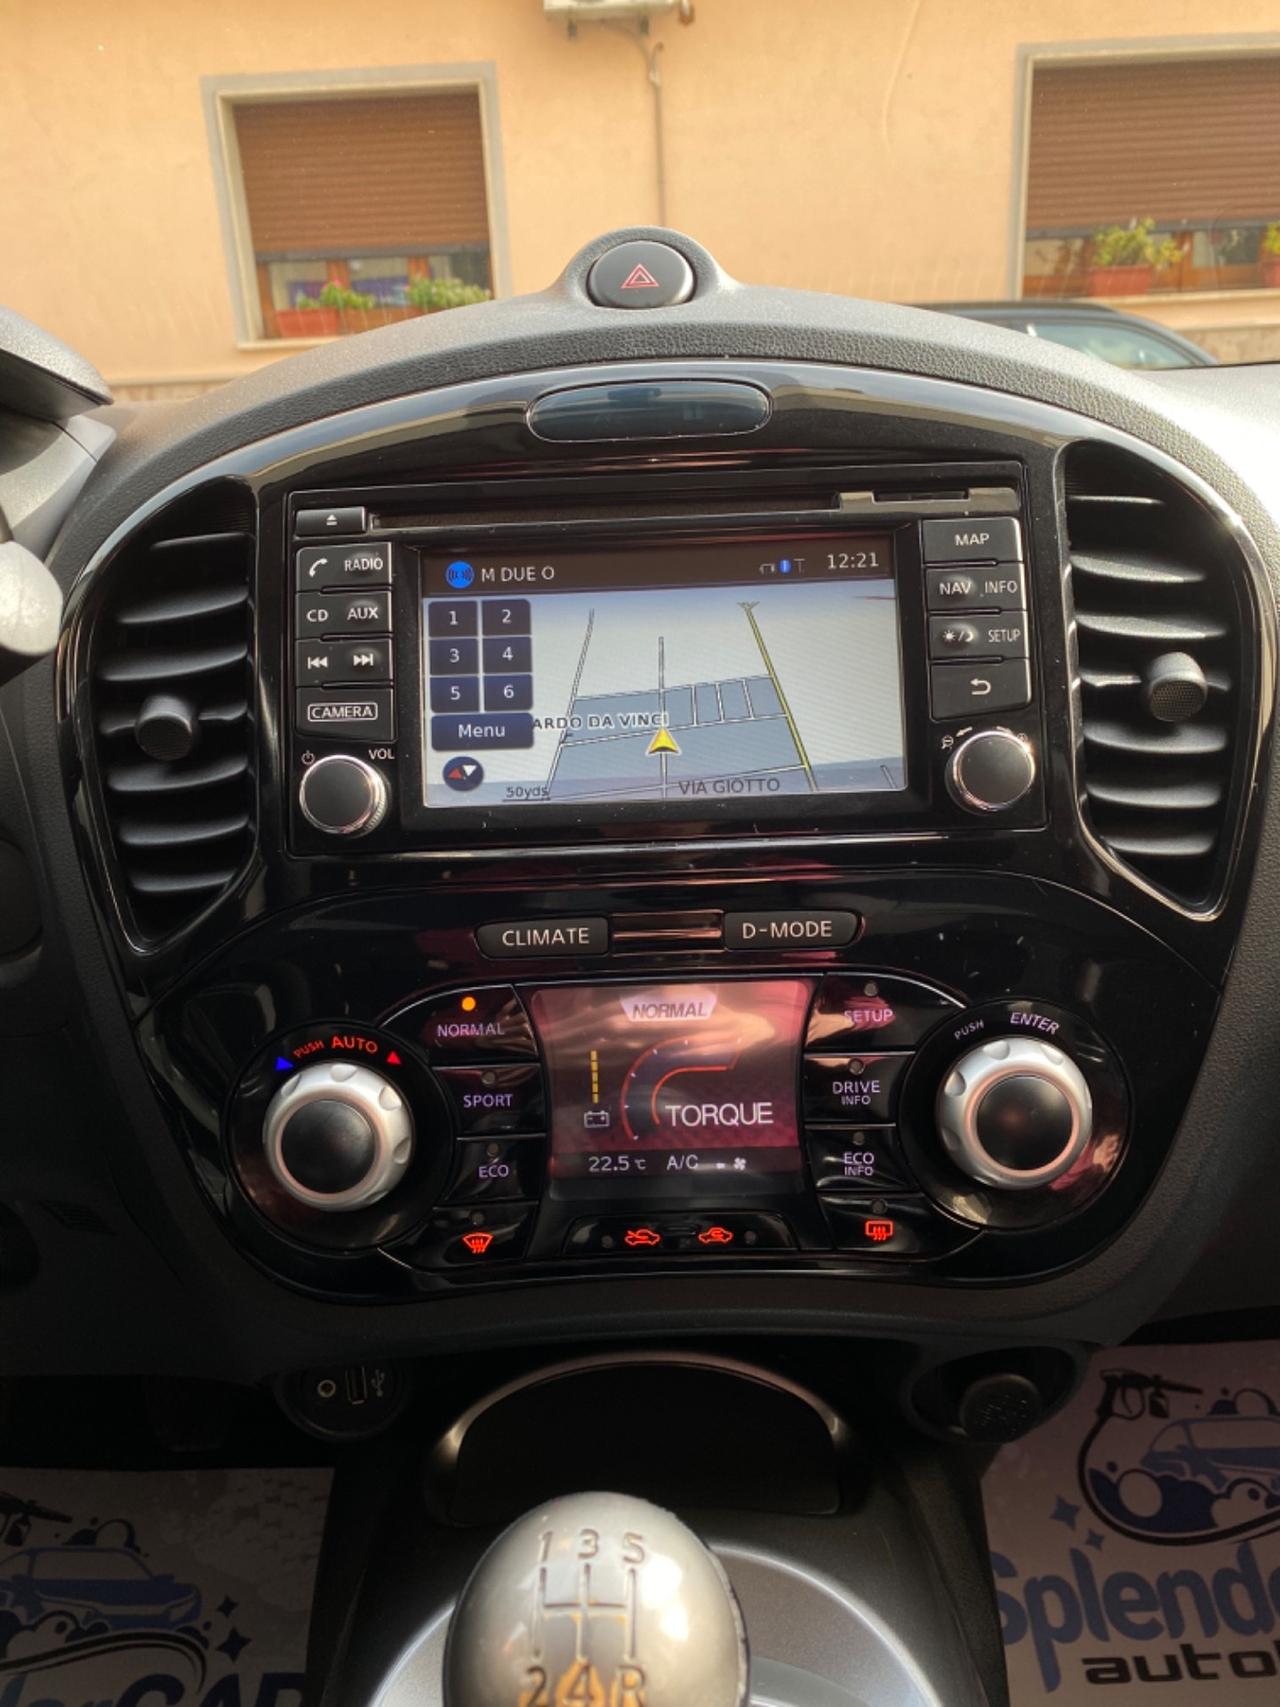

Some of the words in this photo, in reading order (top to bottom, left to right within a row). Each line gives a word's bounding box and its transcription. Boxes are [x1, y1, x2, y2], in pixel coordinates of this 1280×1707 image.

[954, 532, 991, 547] MAP
[343, 557, 384, 572] RADIO
[826, 552, 879, 570] 12:21
[481, 567, 496, 582] M
[500, 566, 536, 582] DUE
[541, 566, 556, 580] O
[939, 581, 972, 595] NAV
[984, 580, 1018, 594] INFO
[306, 609, 329, 623] CD
[347, 606, 380, 620] AUX
[448, 611, 459, 625] 1
[501, 609, 513, 624] 2
[987, 629, 1021, 643] SETUP
[449, 648, 460, 663] 3
[502, 647, 514, 661] 4
[450, 686, 461, 701] 5
[503, 684, 515, 699] 6
[311, 704, 375, 719] CAMERA
[532, 716, 583, 731] ARDO
[588, 714, 614, 728] DA
[619, 712, 669, 727] VINCI
[457, 723, 506, 739] Menu
[368, 748, 395, 761] VOL
[505, 785, 549, 801] 50yds
[679, 780, 710, 795] VIA
[712, 778, 781, 794] GIOTTO
[501, 927, 591, 947] CLIMATE
[742, 920, 833, 940] D-MODE
[632, 1002, 707, 1020] NORMAL
[843, 1008, 894, 1024] SETUP
[436, 1022, 505, 1038] NORMAL
[953, 1018, 985, 1041] PUSH
[1009, 1011, 1060, 1036] ENTER
[293, 1038, 326, 1059] PUSH
[331, 1035, 378, 1055] AUTO
[831, 1079, 880, 1096] DRIVE
[462, 1092, 513, 1108] SPORT
[841, 1094, 871, 1106] INFO
[665, 1102, 775, 1127] TORQUE
[588, 1155, 630, 1172] 22.5
[666, 1154, 699, 1171] A/C
[843, 1152, 875, 1167] ECO
[477, 1164, 510, 1179] ECO
[843, 1164, 874, 1177] INFO
[537, 1529, 553, 1562] 1
[577, 1528, 600, 1560] 3
[622, 1531, 646, 1564] 5
[990, 1541, 1280, 1693] Splend
[1081, 1640, 1280, 1686] auto
[525, 1665, 548, 1707] 2
[565, 1663, 596, 1704] 4
[617, 1664, 646, 1707] R
